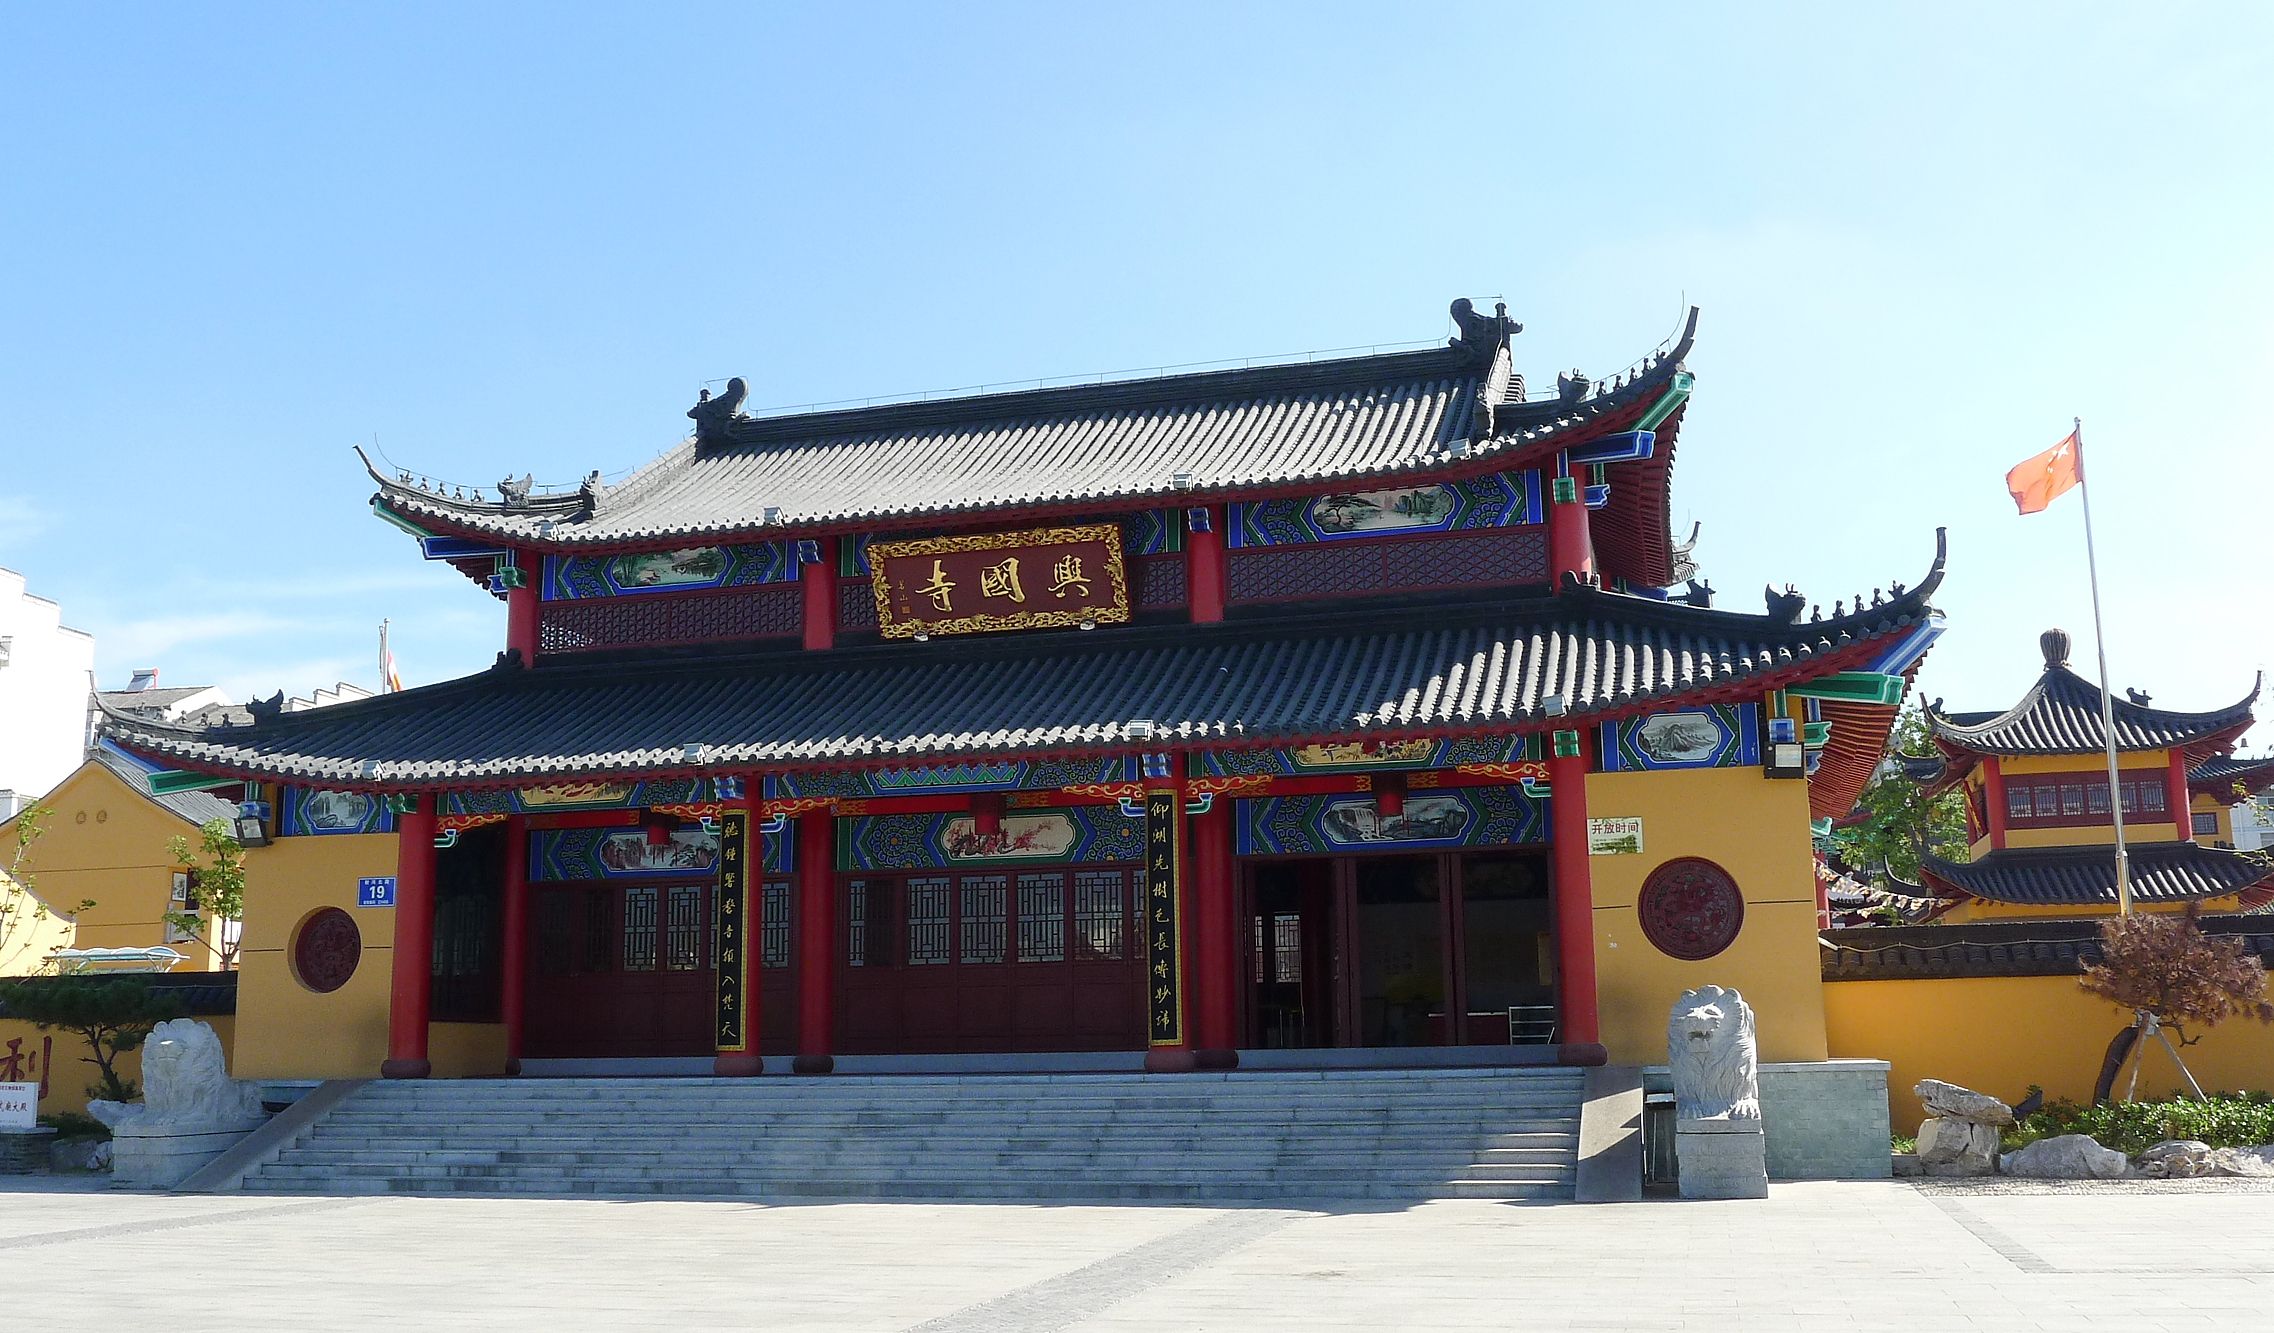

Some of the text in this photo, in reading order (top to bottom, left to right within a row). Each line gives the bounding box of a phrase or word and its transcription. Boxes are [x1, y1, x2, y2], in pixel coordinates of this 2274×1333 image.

[915, 554, 1092, 613] 興國寺
[1591, 822, 1639, 834] 开放时间
[369, 885, 385, 899] 19
